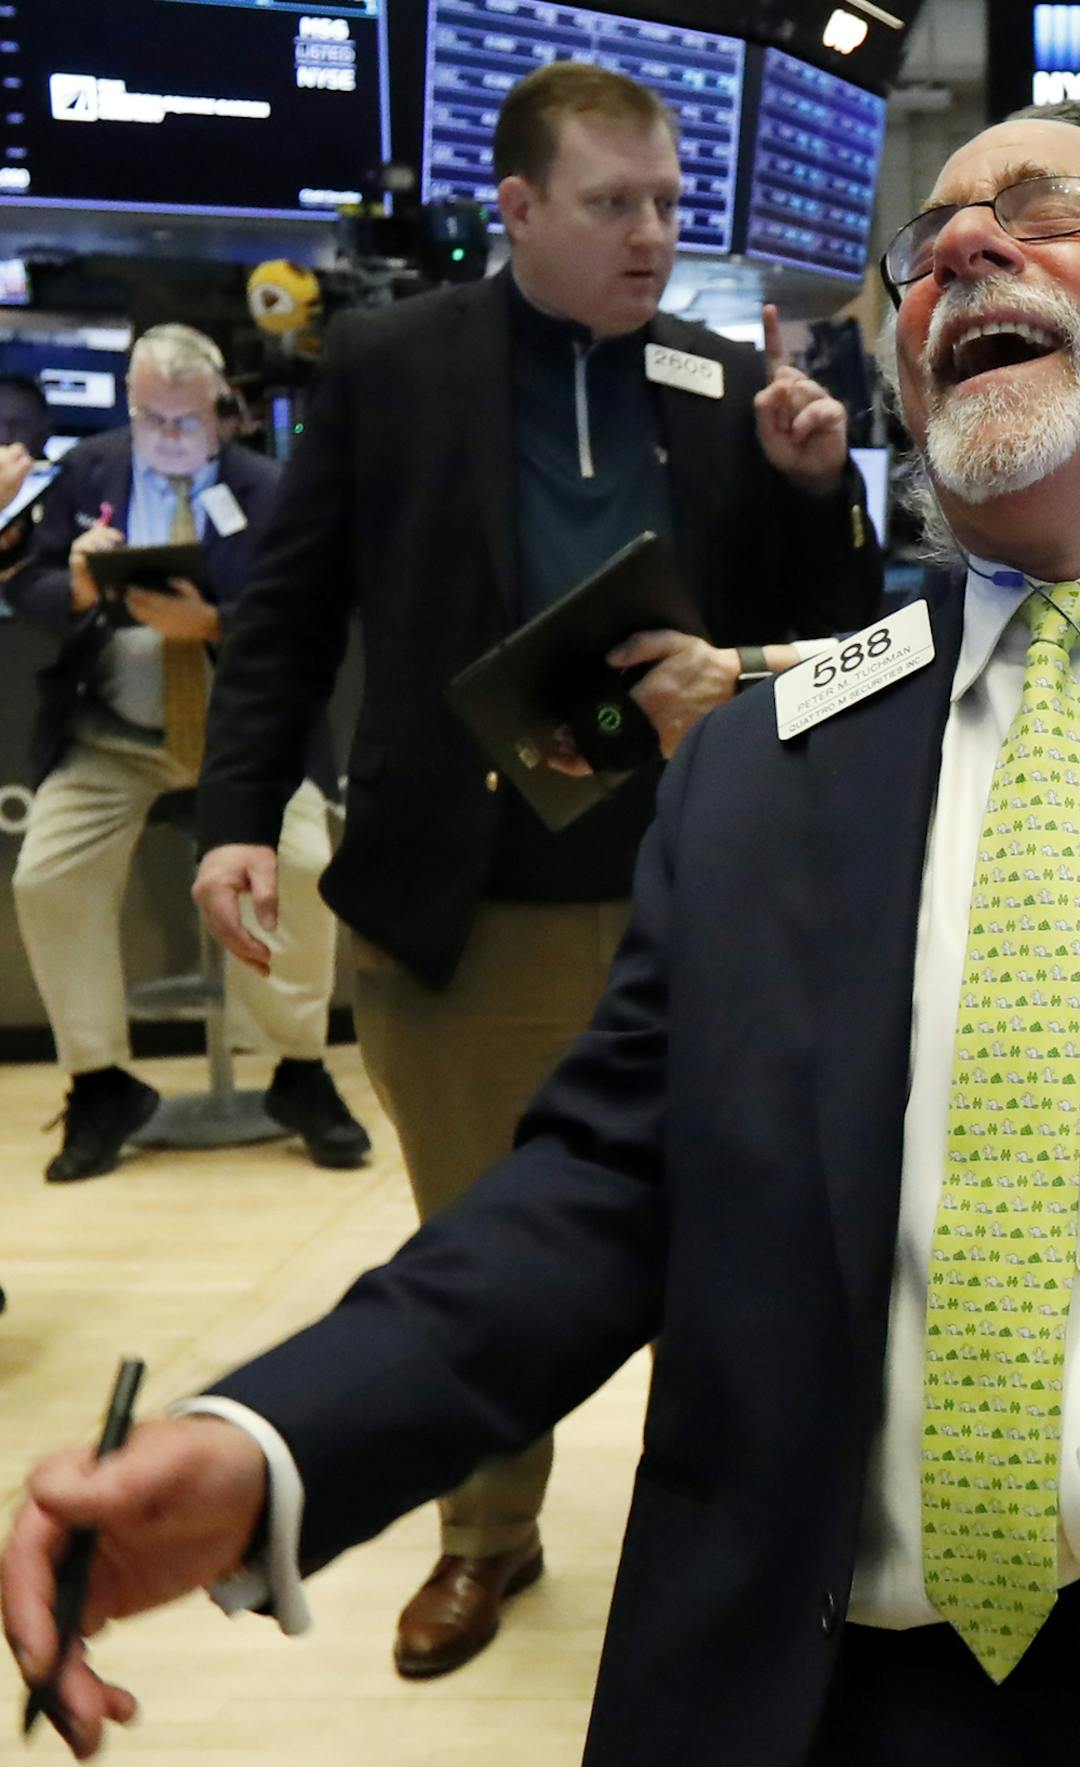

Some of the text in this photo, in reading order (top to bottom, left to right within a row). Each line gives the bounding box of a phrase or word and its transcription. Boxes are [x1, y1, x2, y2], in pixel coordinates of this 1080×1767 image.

[296, 67, 356, 91] NYSE
[797, 685, 834, 712] PETER
[854, 645, 912, 680] TUCHMAN
[812, 628, 892, 687] 588
[789, 703, 836, 733] QUATTRO
[849, 666, 904, 699] SECURITIES
